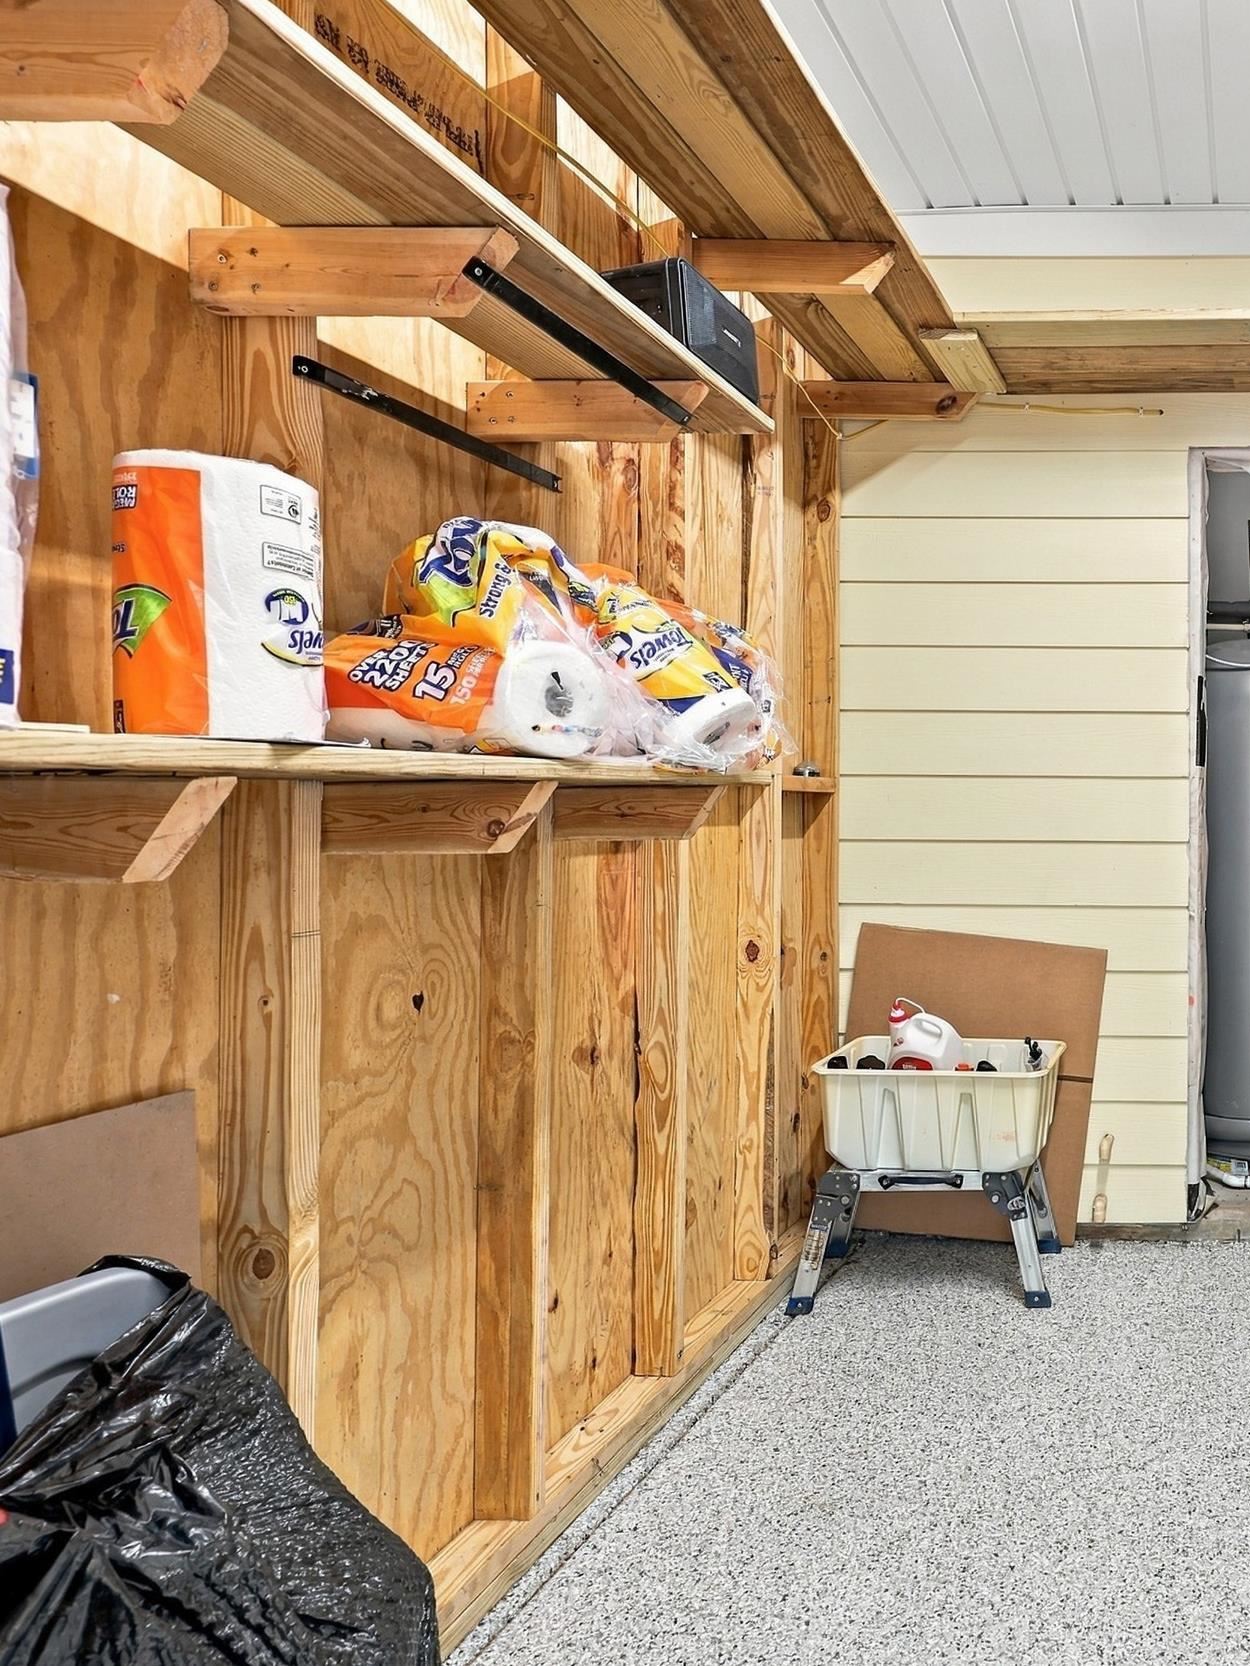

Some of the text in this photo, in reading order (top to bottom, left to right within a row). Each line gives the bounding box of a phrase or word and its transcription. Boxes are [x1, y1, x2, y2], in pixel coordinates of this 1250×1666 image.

[479, 562, 511, 618] Strong &
[350, 650, 388, 682] OVER
[630, 627, 693, 669] Towels
[414, 662, 456, 700] 15
